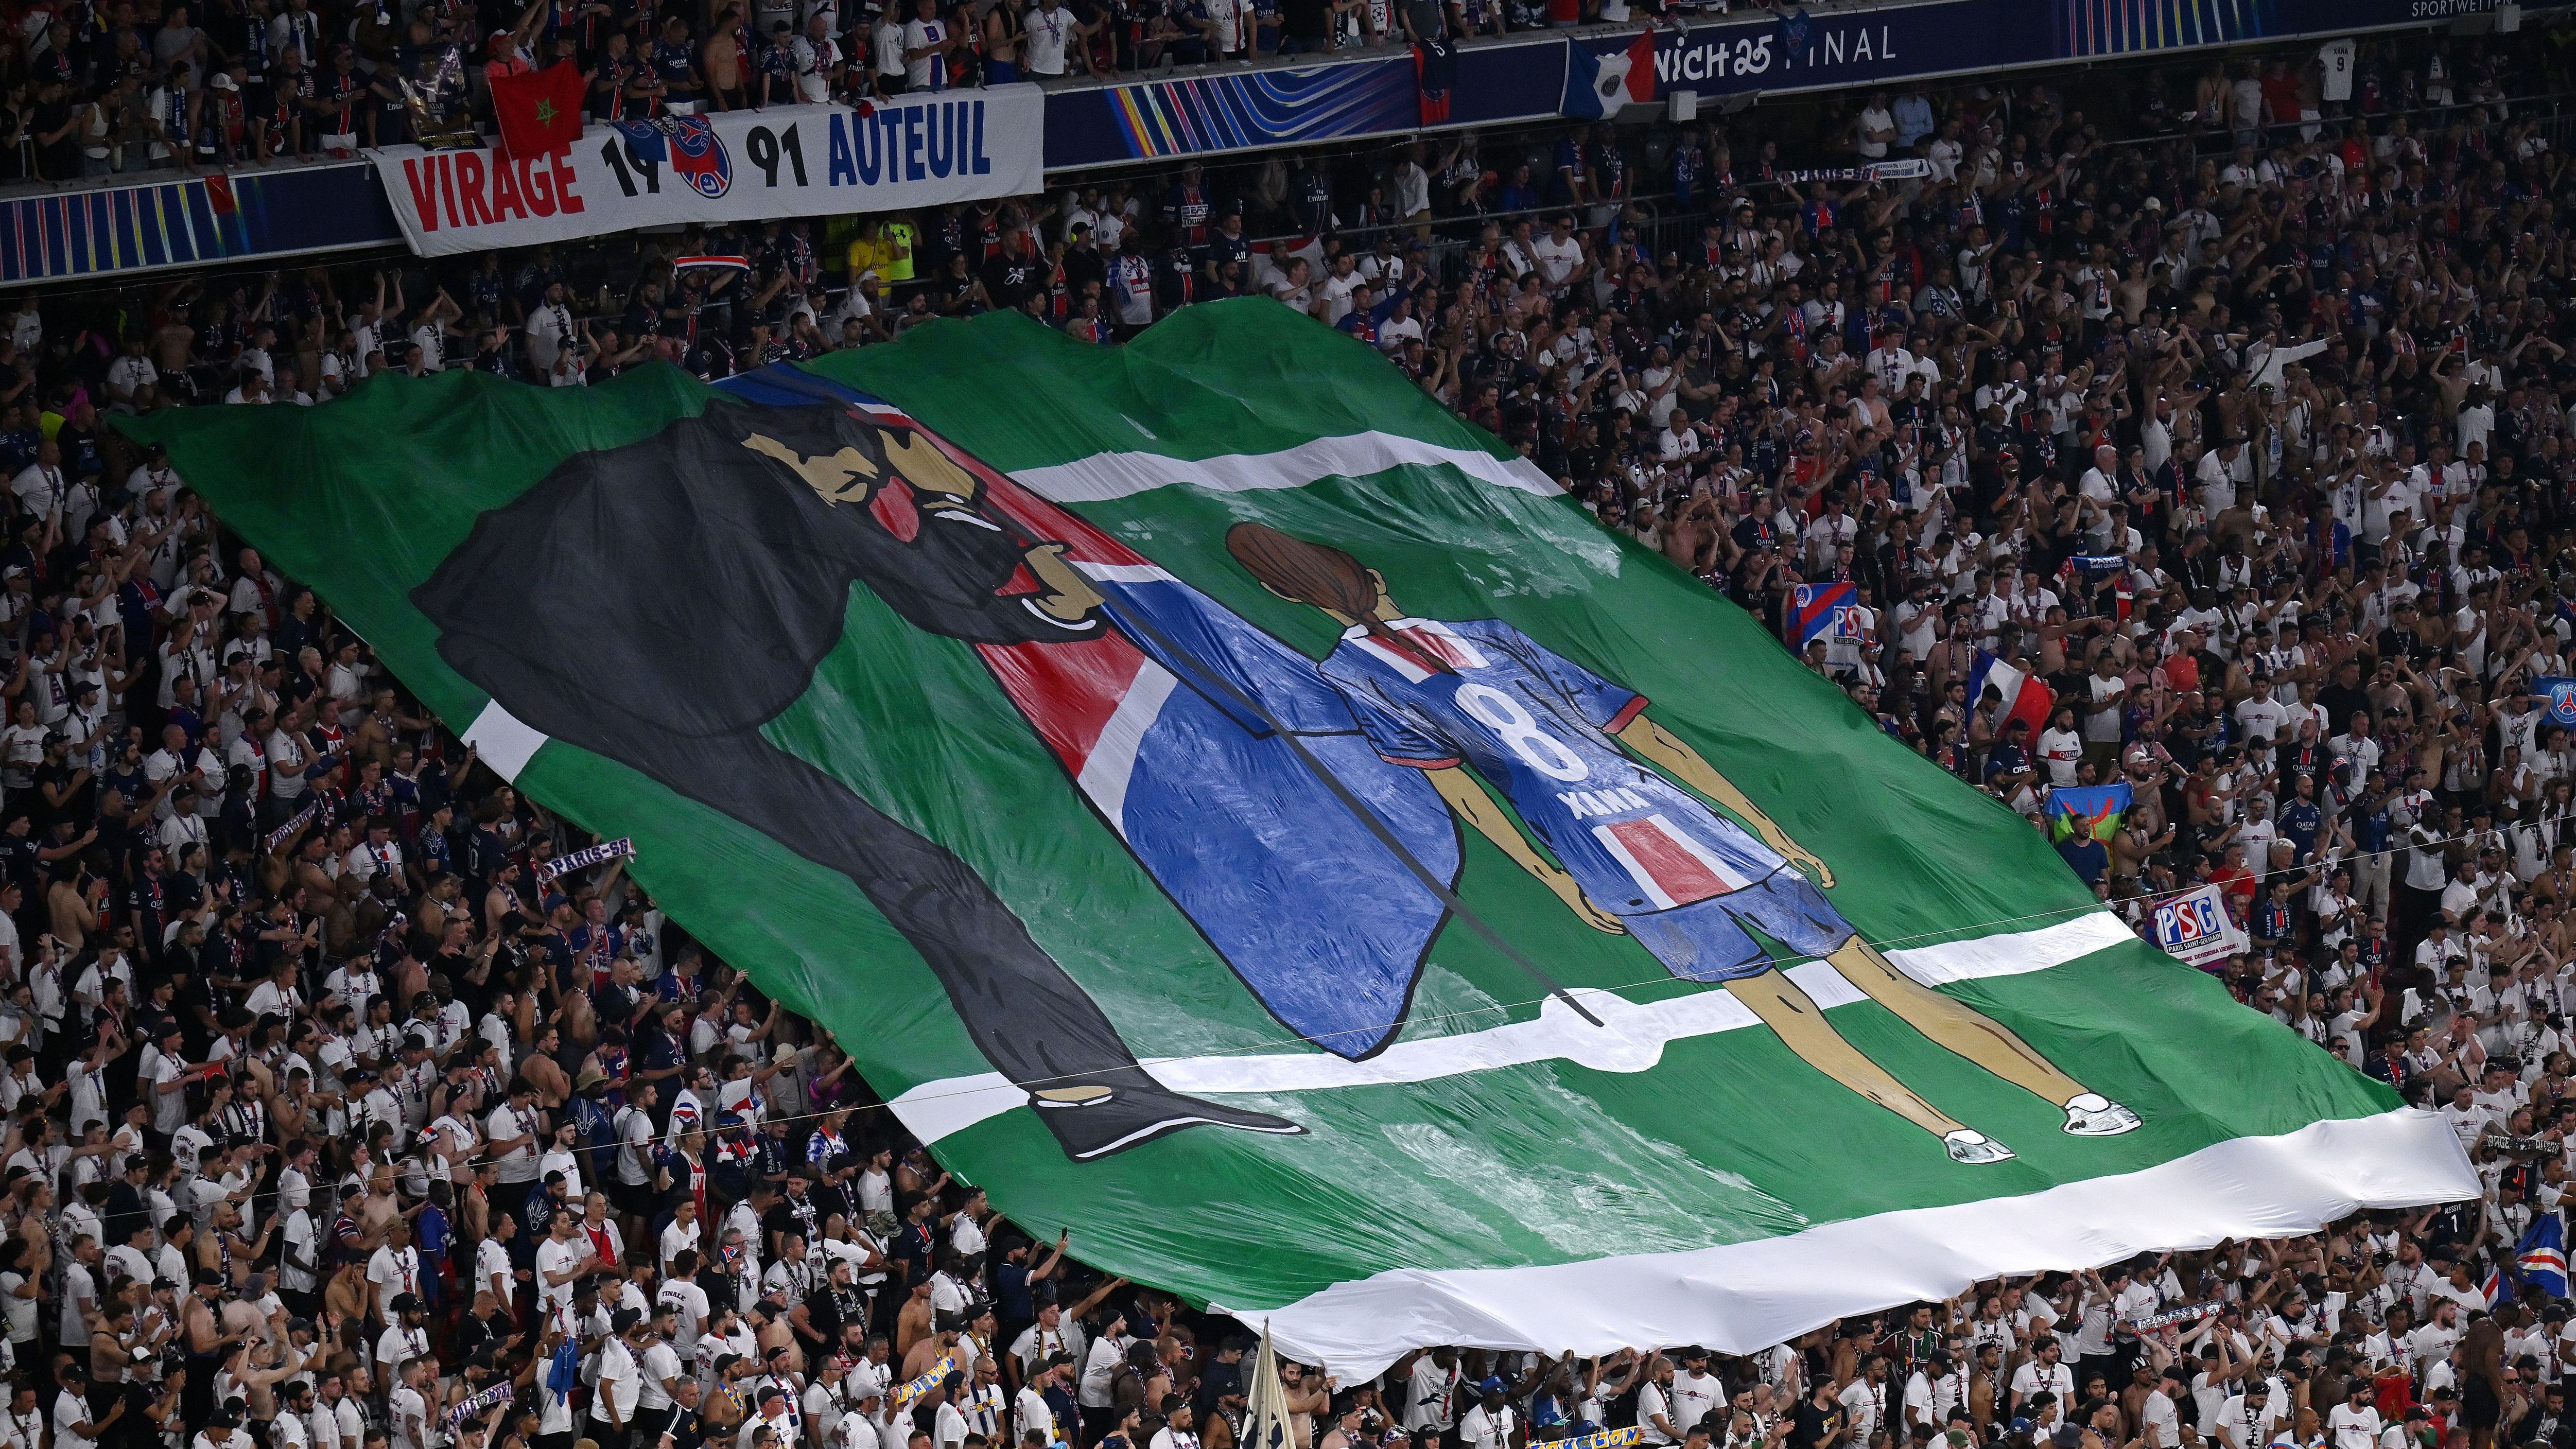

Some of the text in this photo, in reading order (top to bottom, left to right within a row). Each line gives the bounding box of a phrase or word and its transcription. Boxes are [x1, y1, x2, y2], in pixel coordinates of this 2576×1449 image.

[1653, 37, 1732, 82] NICH
[1734, 34, 1774, 75] 25
[2337, 57, 2344, 72] 9
[404, 100, 990, 232] VIRAGE 19 91 AUTEUIL
[1836, 608, 1863, 636] PS
[1455, 683, 1589, 781] 8
[2013, 764, 2032, 774] OPEL
[1556, 787, 1650, 820] XANA
[2296, 822, 2316, 830] QATAR
[556, 841, 629, 875] PARIS-SG
[2165, 900, 2218, 942] PSG
[2169, 934, 2222, 954] PARIS SAINT-GERMAIN
[736, 1155, 755, 1168] QTAR
[2444, 1204, 2462, 1215] ALESSYO
[2451, 1215, 2458, 1231] 1
[109, 1255, 128, 1267] FINALE
[662, 1290, 686, 1302] FINALE
[1429, 1382, 1452, 1391] QATAR
